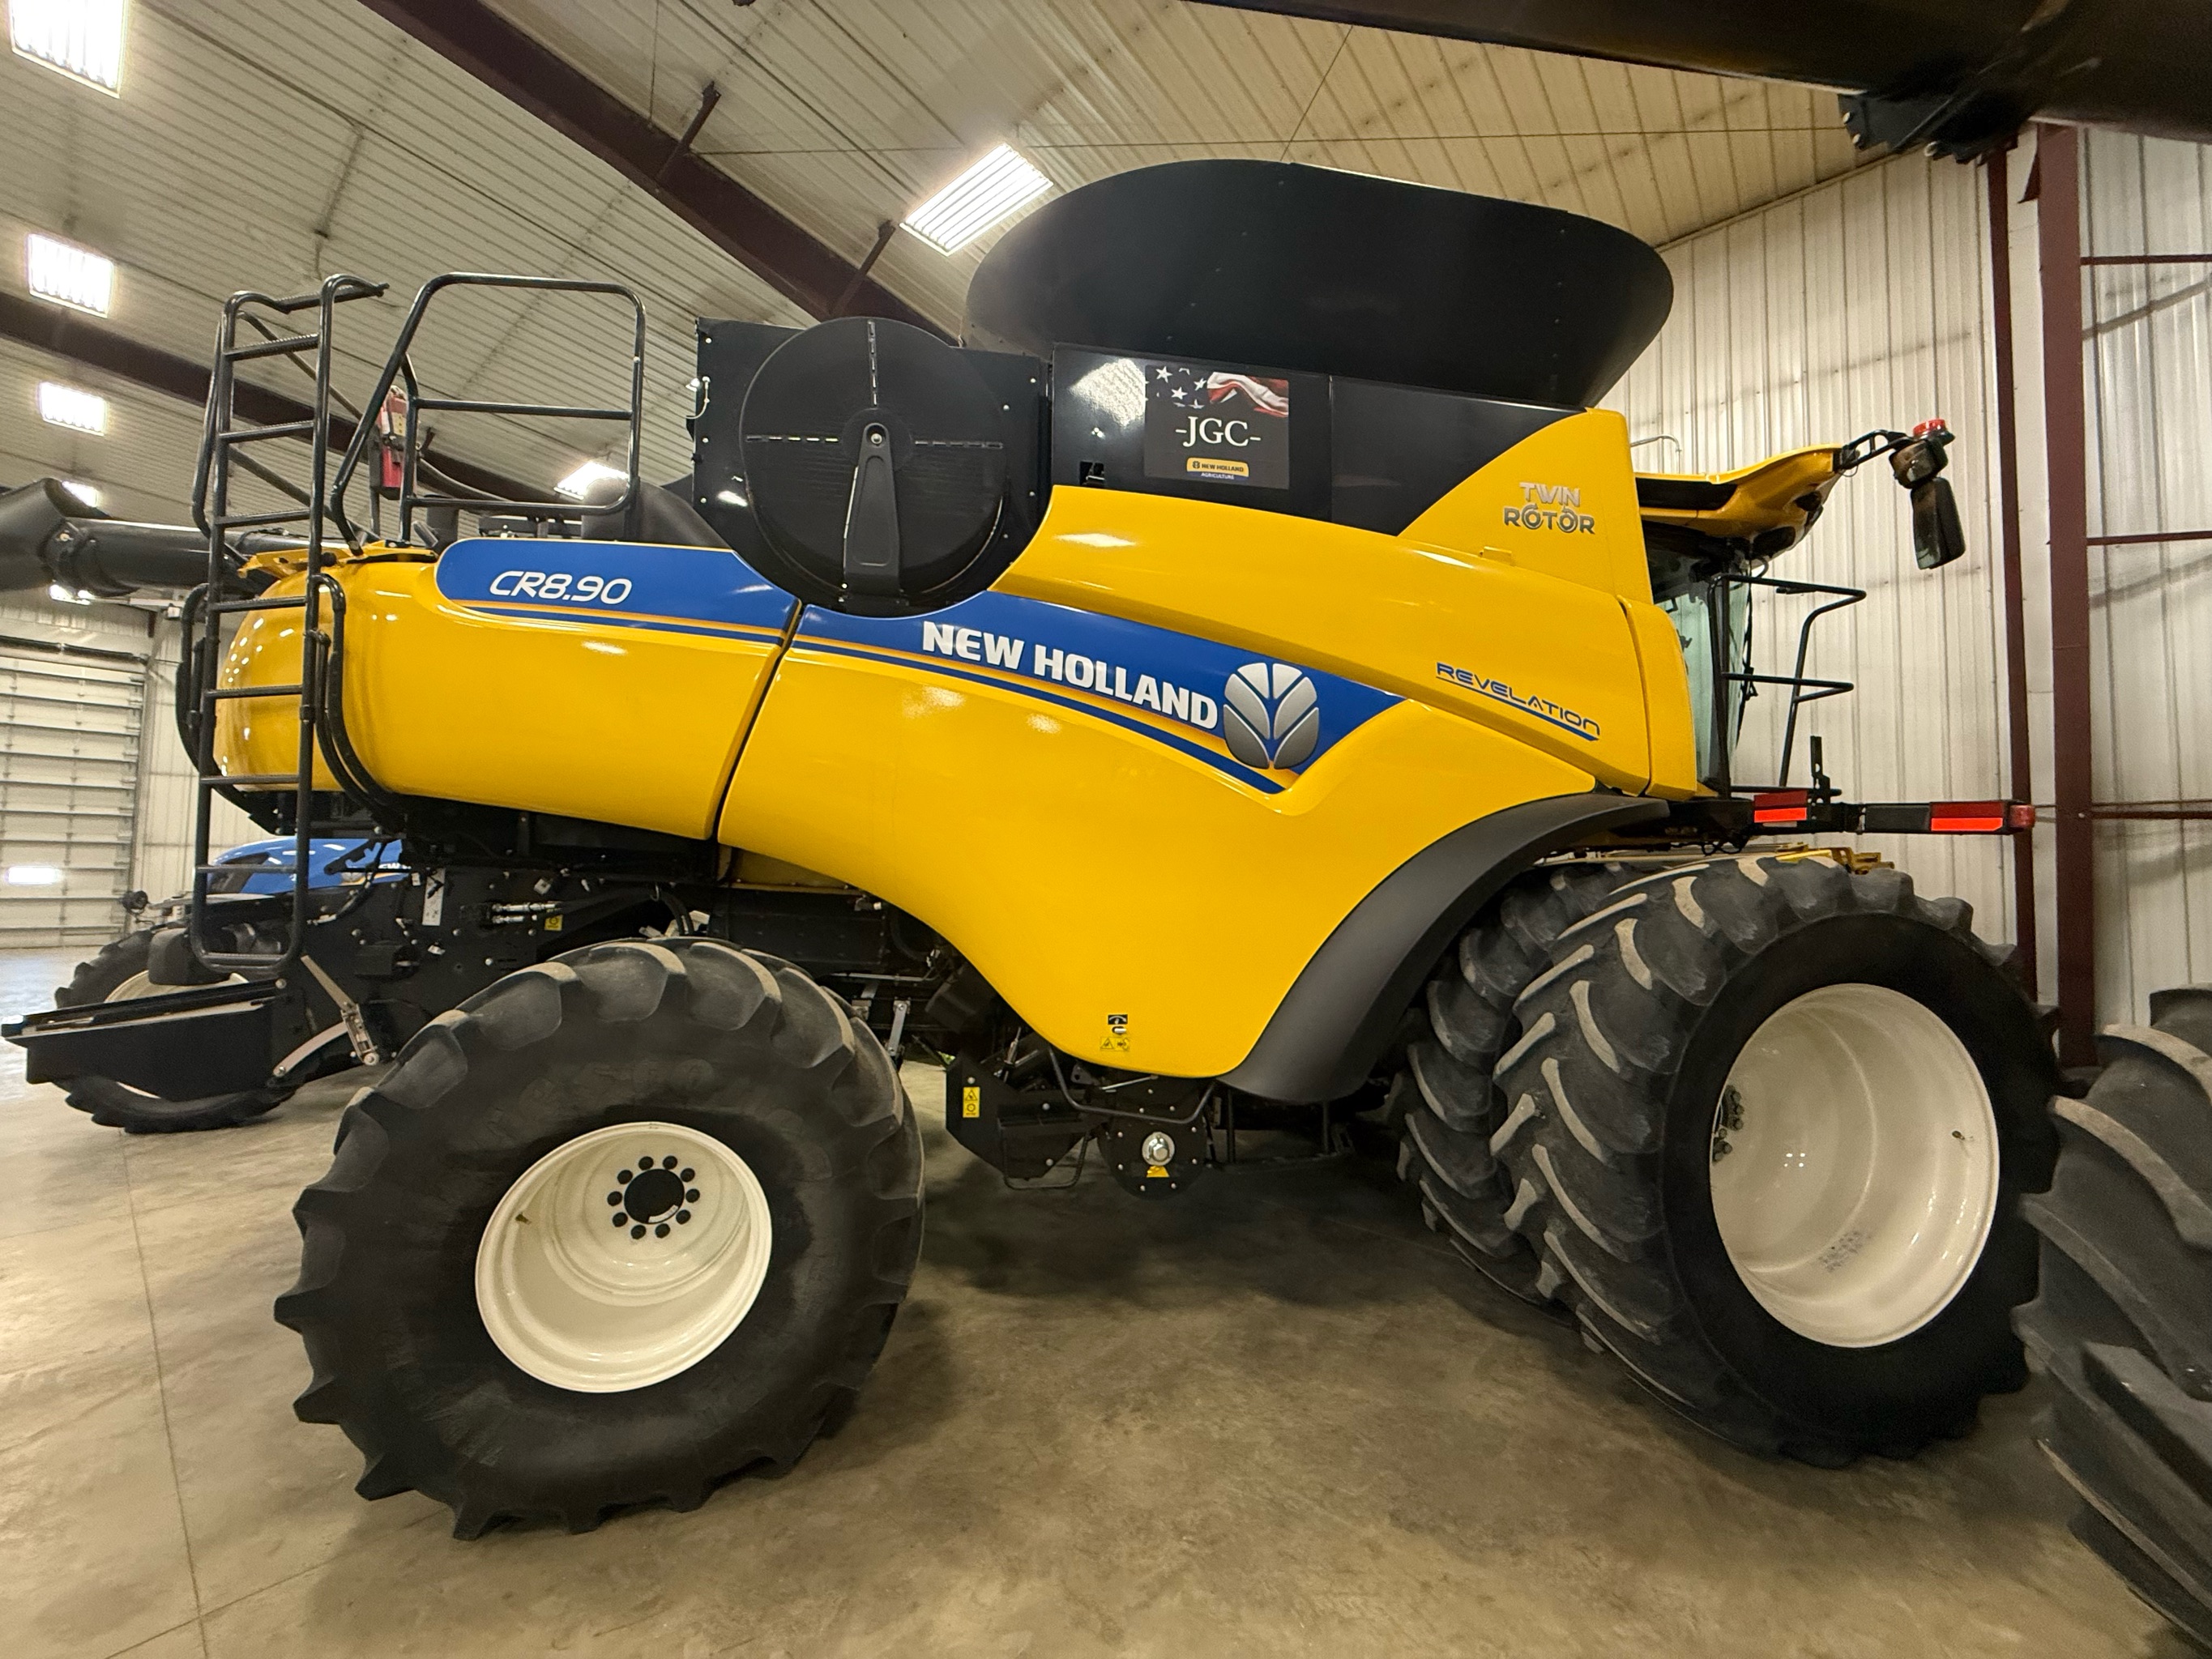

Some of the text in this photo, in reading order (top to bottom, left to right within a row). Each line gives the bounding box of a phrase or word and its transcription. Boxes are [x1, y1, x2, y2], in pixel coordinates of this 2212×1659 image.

[1519, 482, 1580, 507] TWIN
[1504, 504, 1595, 535] ROTOR
[489, 571, 632, 604] CR8.90
[923, 621, 1219, 730] NEW HOLLAND
[1437, 661, 1601, 736] REVELATION
